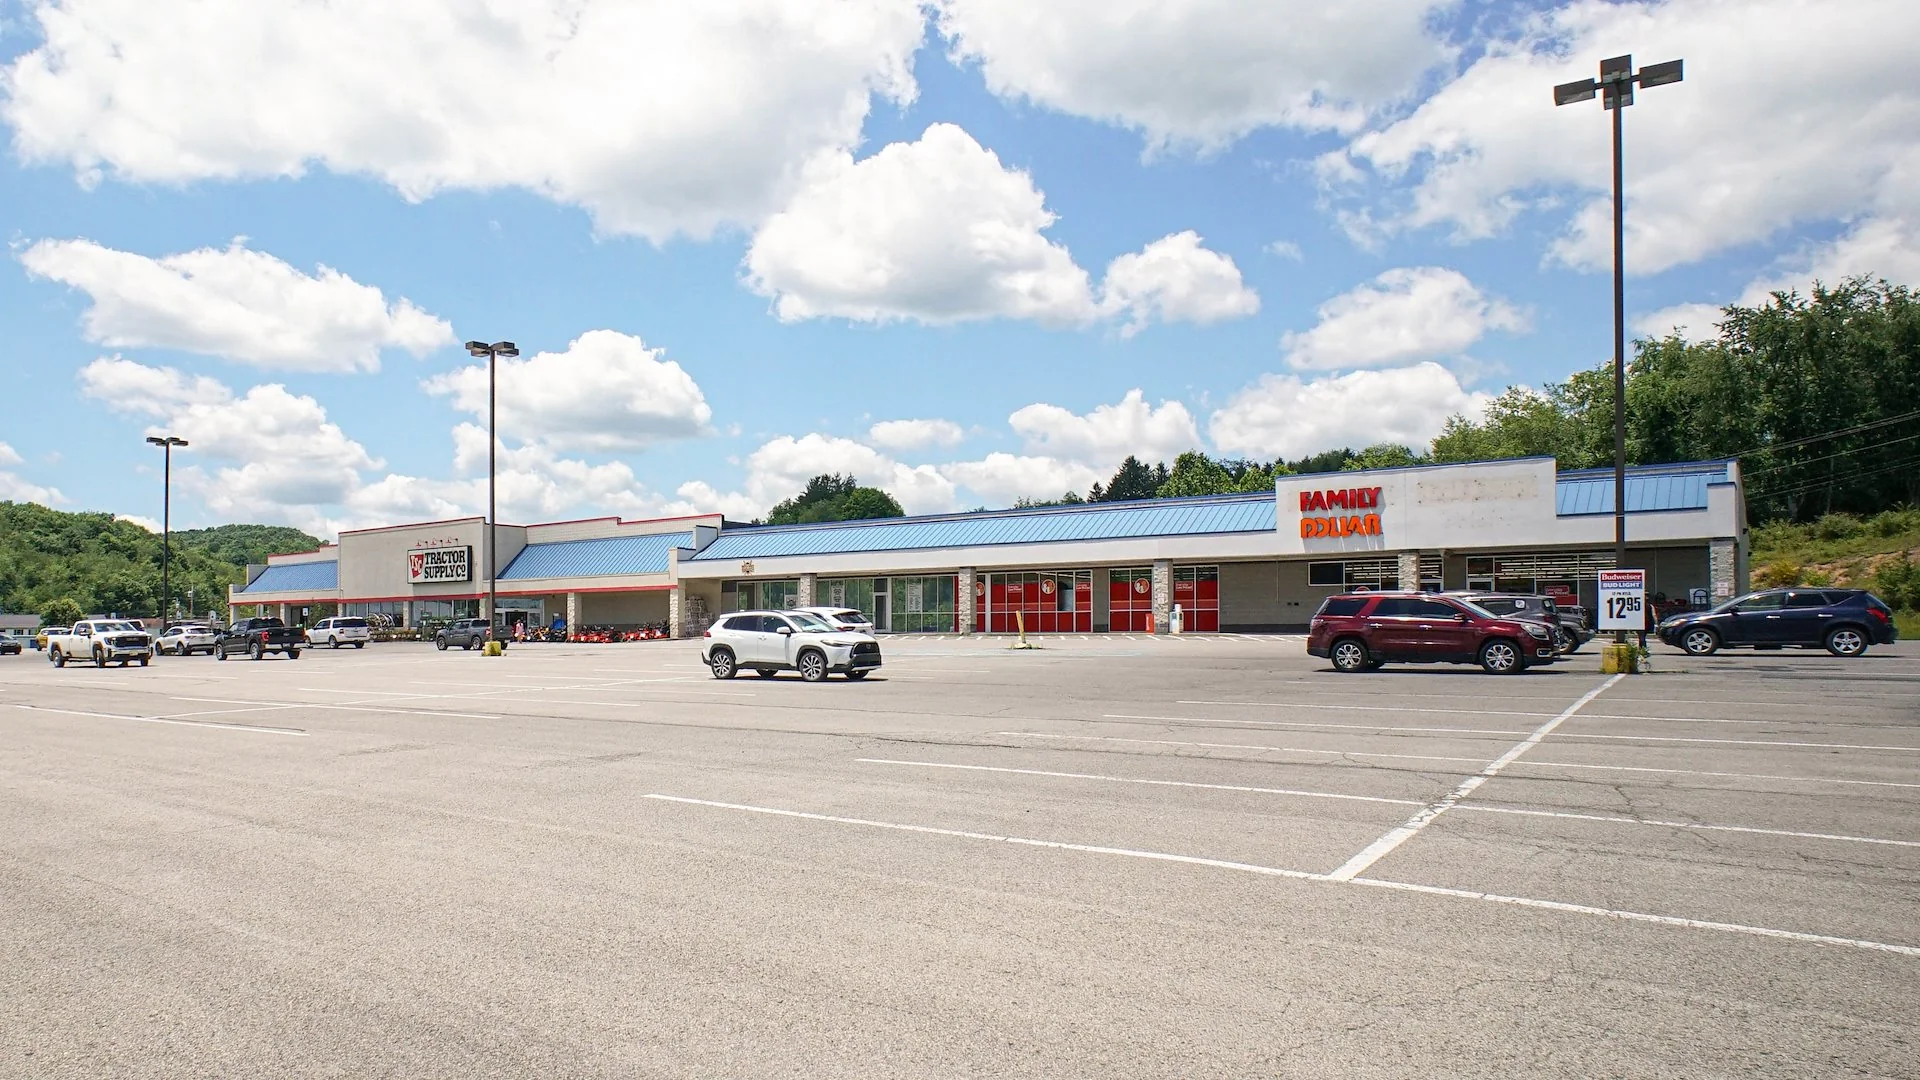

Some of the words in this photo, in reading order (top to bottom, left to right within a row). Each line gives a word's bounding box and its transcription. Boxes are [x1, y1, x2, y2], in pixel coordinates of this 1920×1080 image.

[1300, 487, 1382, 511] FAMILY
[1301, 513, 1381, 538] DOLLAR
[424, 550, 466, 565] TRACTOR
[424, 564, 456, 579] SUPPLY
